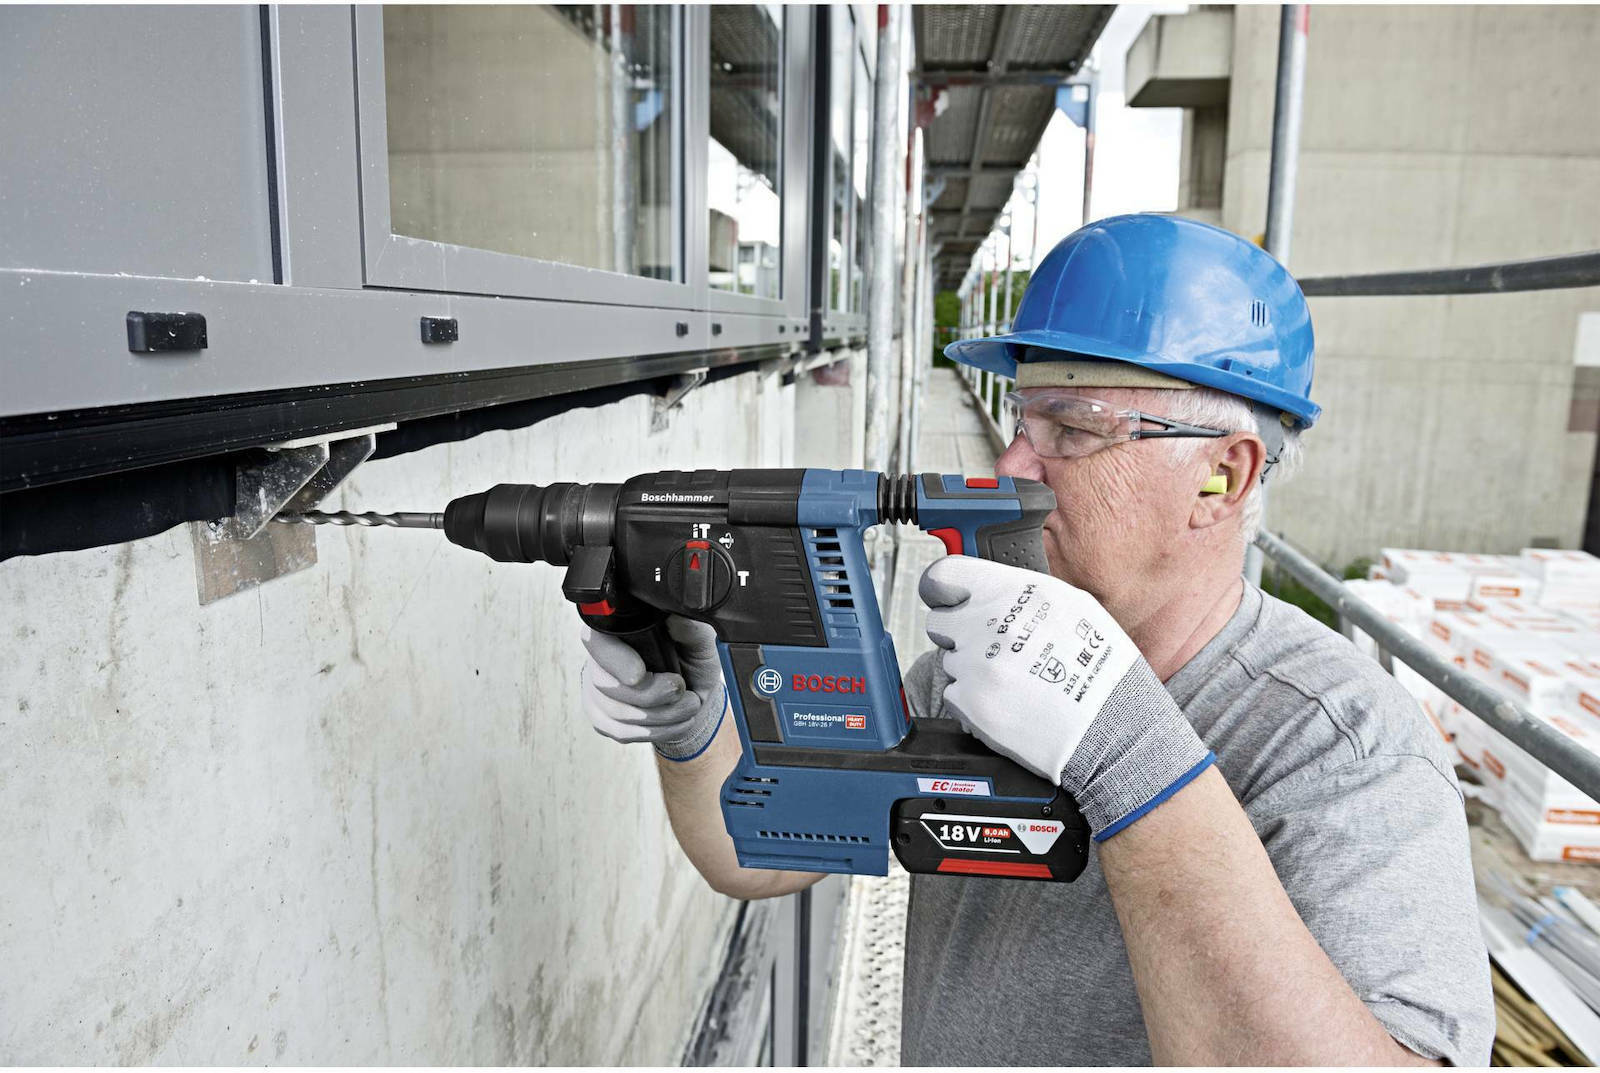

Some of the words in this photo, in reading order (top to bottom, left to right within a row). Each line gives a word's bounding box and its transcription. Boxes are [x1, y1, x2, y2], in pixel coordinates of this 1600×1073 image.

[641, 493, 714, 502] Boschhammer
[997, 584, 1037, 634] BOSCH
[1029, 661, 1042, 675] EN
[792, 673, 866, 694] BOSCH
[793, 712, 845, 722] Professional
[931, 781, 949, 791] EC
[940, 824, 981, 842] 18V
[1029, 825, 1058, 833] BOSCH
